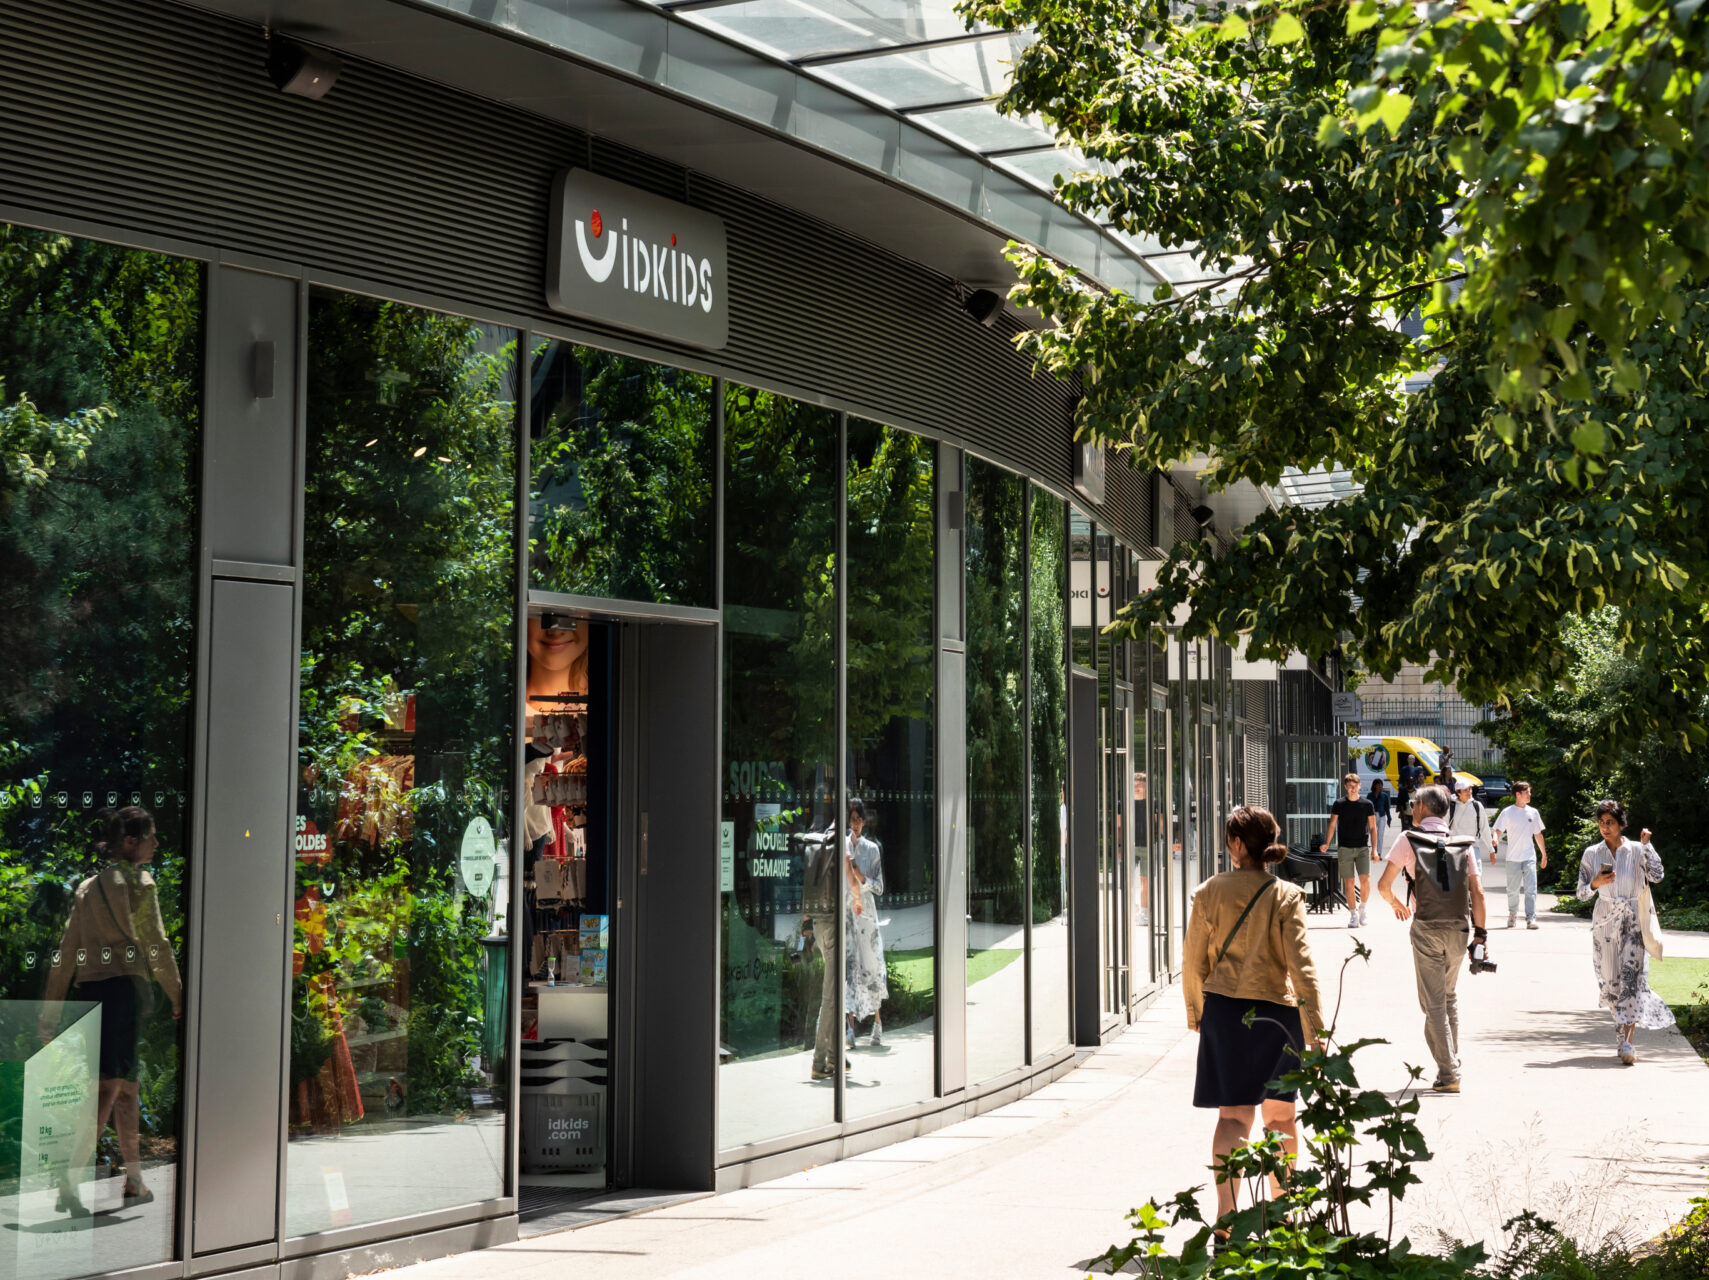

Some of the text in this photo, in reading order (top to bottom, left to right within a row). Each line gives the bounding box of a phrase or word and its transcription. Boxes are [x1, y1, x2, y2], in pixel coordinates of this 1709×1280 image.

[296, 815, 306, 831] ES
[295, 834, 326, 850] OLDES
[548, 1118, 589, 1130] idkids
[548, 1130, 581, 1140] .com
